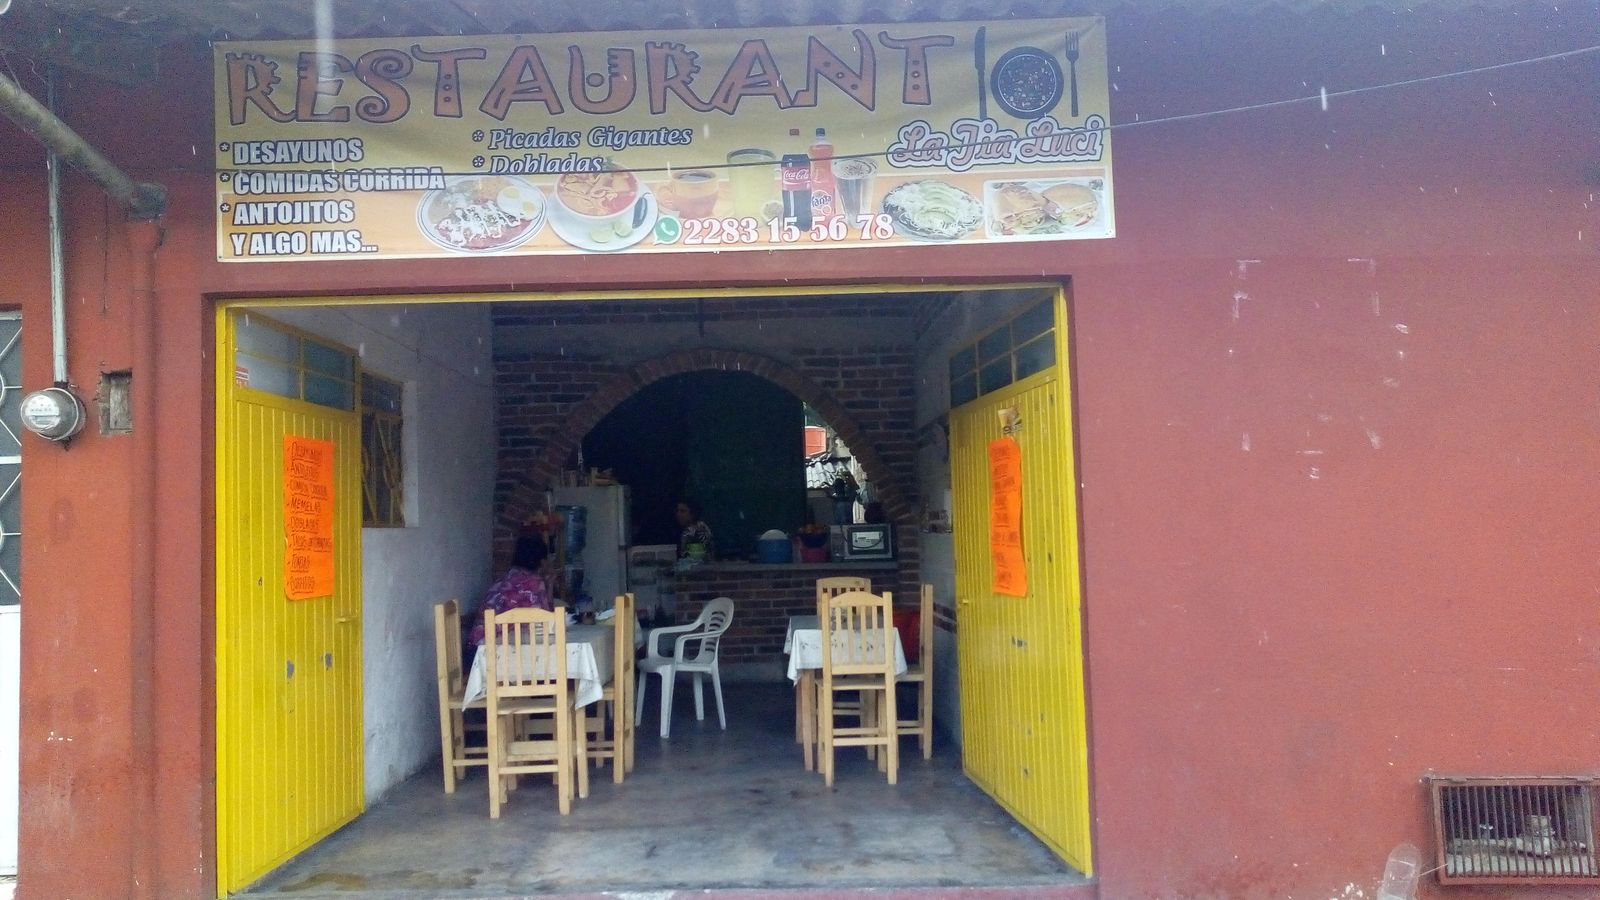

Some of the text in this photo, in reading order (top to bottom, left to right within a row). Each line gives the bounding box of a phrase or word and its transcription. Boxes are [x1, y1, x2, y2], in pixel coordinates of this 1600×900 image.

[226, 27, 955, 125] RESTAURANT
[232, 138, 364, 165] DESAYUNOS
[488, 125, 694, 151] Picadas Gigantes
[891, 118, 1103, 170] La Tia Luci
[489, 152, 603, 174] Dobladas
[233, 167, 446, 194] COMIDAS CORRIDA
[232, 200, 355, 225] ANTOJITOS
[683, 212, 895, 245] 2283 15 56 78
[230, 230, 378, 255] Y ALGO MAS...
